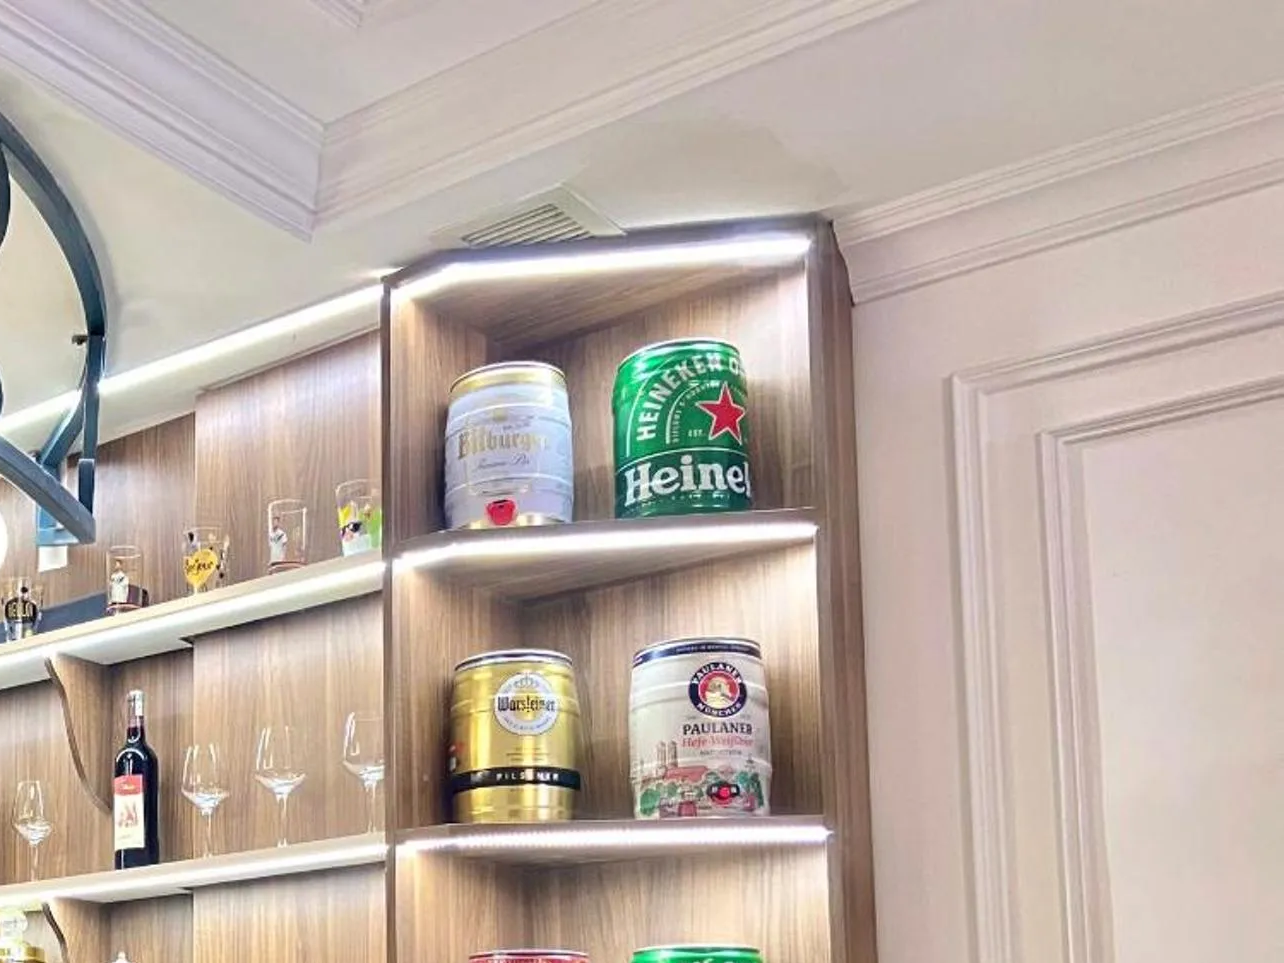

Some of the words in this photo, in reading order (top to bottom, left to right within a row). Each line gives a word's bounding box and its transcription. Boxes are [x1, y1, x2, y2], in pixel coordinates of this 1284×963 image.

[636, 351, 723, 441] HEINEKEN
[497, 695, 556, 713] Warsteiner
[682, 721, 753, 736] PAULANER
[496, 770, 559, 782] PILSNER
